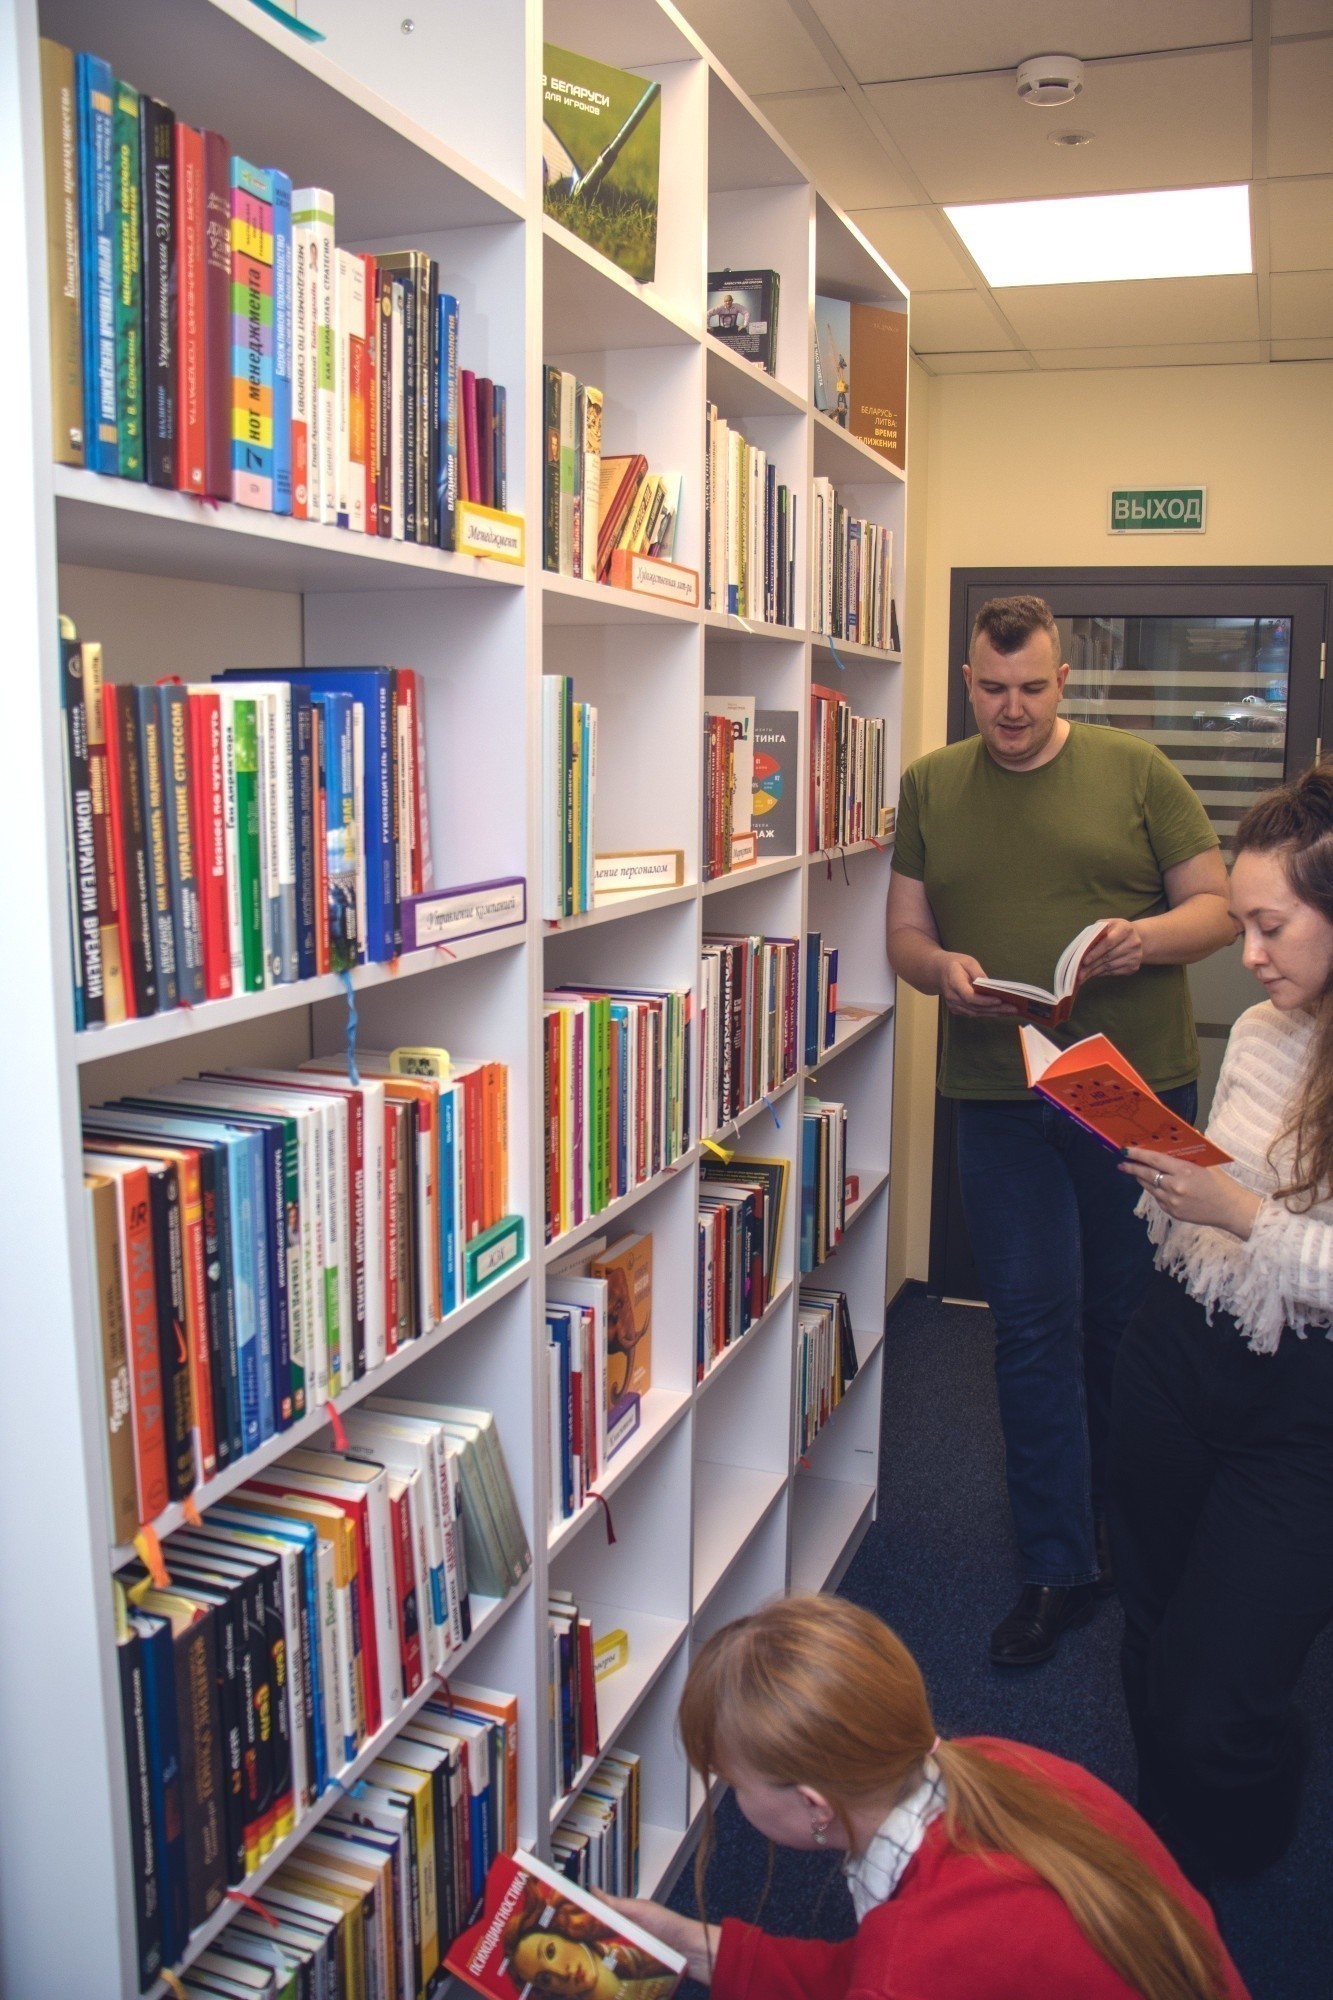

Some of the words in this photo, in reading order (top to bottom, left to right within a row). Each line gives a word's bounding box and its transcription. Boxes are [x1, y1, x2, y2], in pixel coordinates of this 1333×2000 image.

[544, 91, 562, 103] ДЛЯ
[563, 97, 600, 115] ИГРОКОВ
[550, 77, 610, 107] БЕЛАРУСИ
[119, 145, 131, 215] ТОРГОВОГО
[155, 164, 171, 242] ЭЛИТА
[98, 235, 115, 340] КОРПОРАТИВНЫЙ
[121, 220, 132, 306] МЕНЕДЖМЕНТ
[275, 233, 286, 310] производство
[298, 243, 306, 332] МЕНЕДЖМЕНТ
[323, 237, 331, 291] СТРАТЕГИЮ
[159, 243, 172, 368] Управленческая
[248, 267, 263, 402] менеджмента
[127, 330, 138, 399] Сорокина
[275, 309, 286, 377] Бережливое
[298, 335, 305, 351] ПО
[447, 314, 456, 377] ТЕХНОЛОГИЯ
[99, 340, 117, 422] МЕНЕДЖМЕНТ
[447, 377, 456, 447] СОЦИАЛЬНАЯ
[861, 405, 894, 418] БЕЛАРУСЬ
[249, 408, 261, 442] нот
[874, 416, 898, 428] ЛИТВА:
[874, 428, 898, 439] ВРЕМЯ
[247, 446, 263, 470] 7
[447, 454, 455, 511] ВЛАДИМИР
[467, 525, 518, 549] Менеджмент
[1114, 498, 1201, 523] ВЫХОД
[171, 702, 186, 782] СТРЕССОМ
[210, 709, 221, 792] чуть-чуть
[379, 687, 388, 749] ПРОЕКТОВ
[146, 723, 161, 808] ПОДЧИНЕННЫХ
[225, 725, 235, 804] директора
[381, 751, 390, 844] РУКОВОДИТЕЛЬ
[175, 784, 193, 881] УПРАВЛЕНИЕ
[212, 793, 222, 815] по
[76, 790, 98, 912] ПОЖИРАТЕЛИ
[151, 809, 165, 886] НАКАЗЫВАТЬ
[211, 817, 225, 877] Бизнес
[619, 861, 668, 879] персоналом
[156, 887, 168, 912] КАК
[427, 905, 474, 931] Управление
[474, 895, 517, 920] компанией
[83, 915, 104, 999] ВРЕМЕНИ
[157, 916, 171, 974] АЛЕКСАНДР
[438, 1461, 451, 1517] ПОЧЕМУ
[467, 1869, 531, 1978] ПСИХОДИАГНОСТИКА
